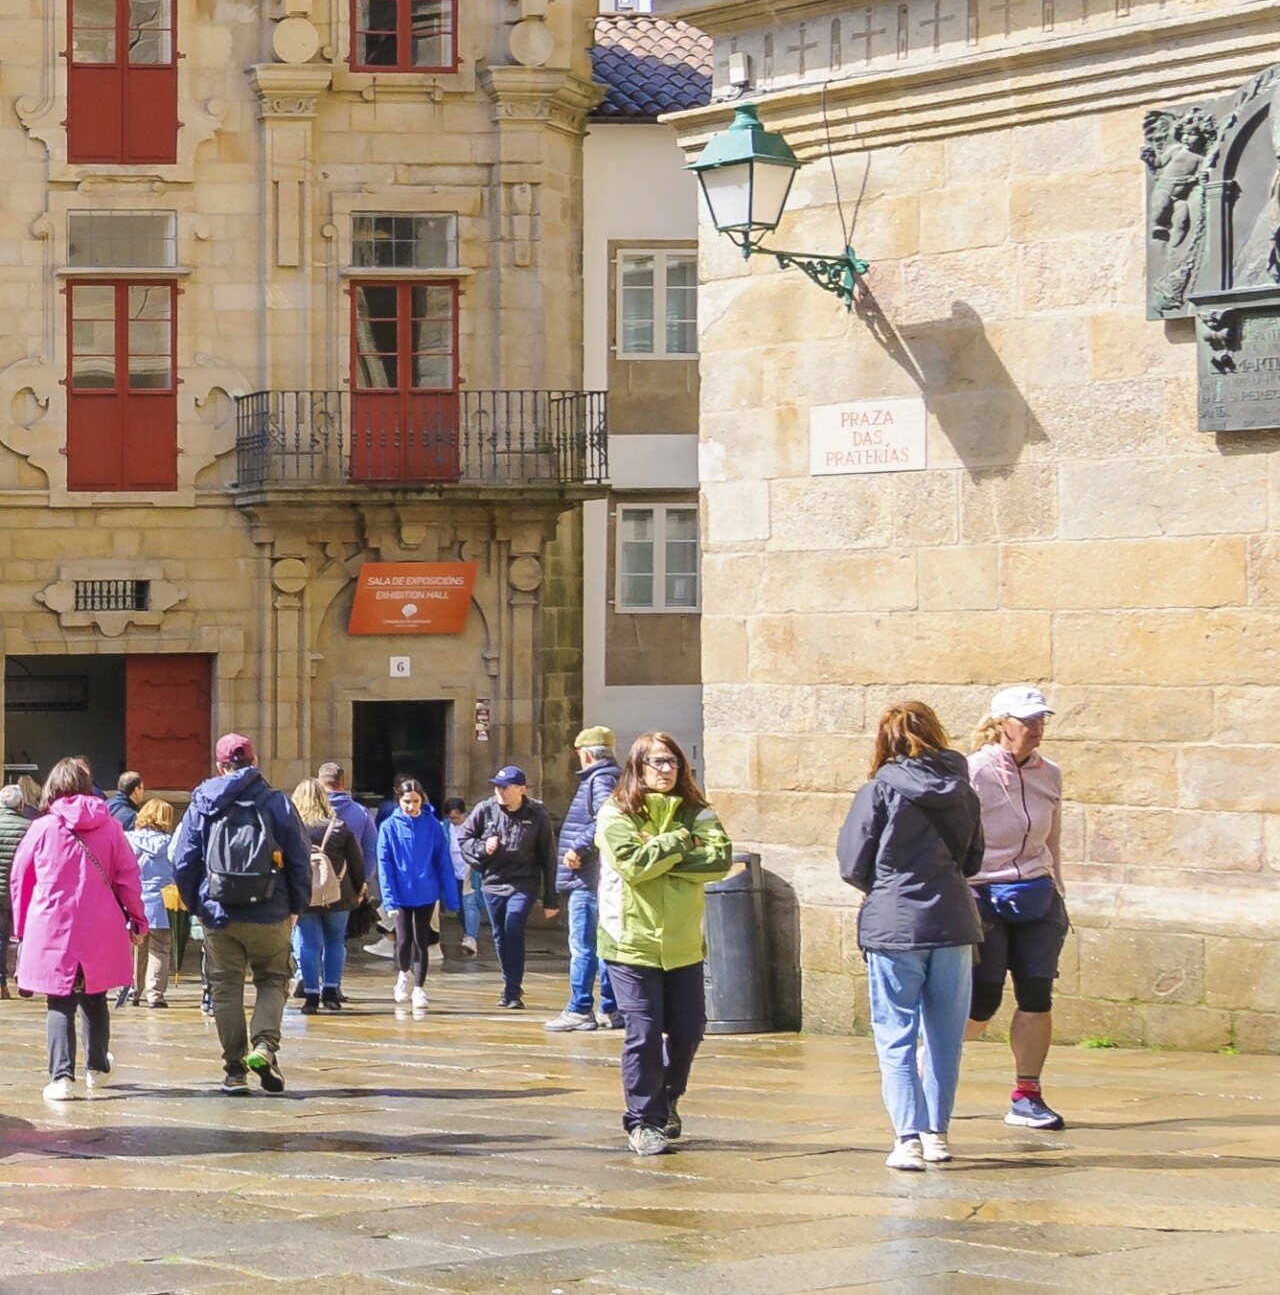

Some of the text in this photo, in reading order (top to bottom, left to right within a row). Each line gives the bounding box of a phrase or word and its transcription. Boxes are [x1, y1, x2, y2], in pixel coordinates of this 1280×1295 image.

[841, 410, 894, 427] PRAZA
[853, 430, 883, 446] DAS
[826, 443, 910, 467] PRATERÍAS
[367, 575, 464, 585] SALA DE EXPOSICIÓNS
[376, 591, 449, 599] EXHIBITION HALL
[396, 661, 405, 673] 6
